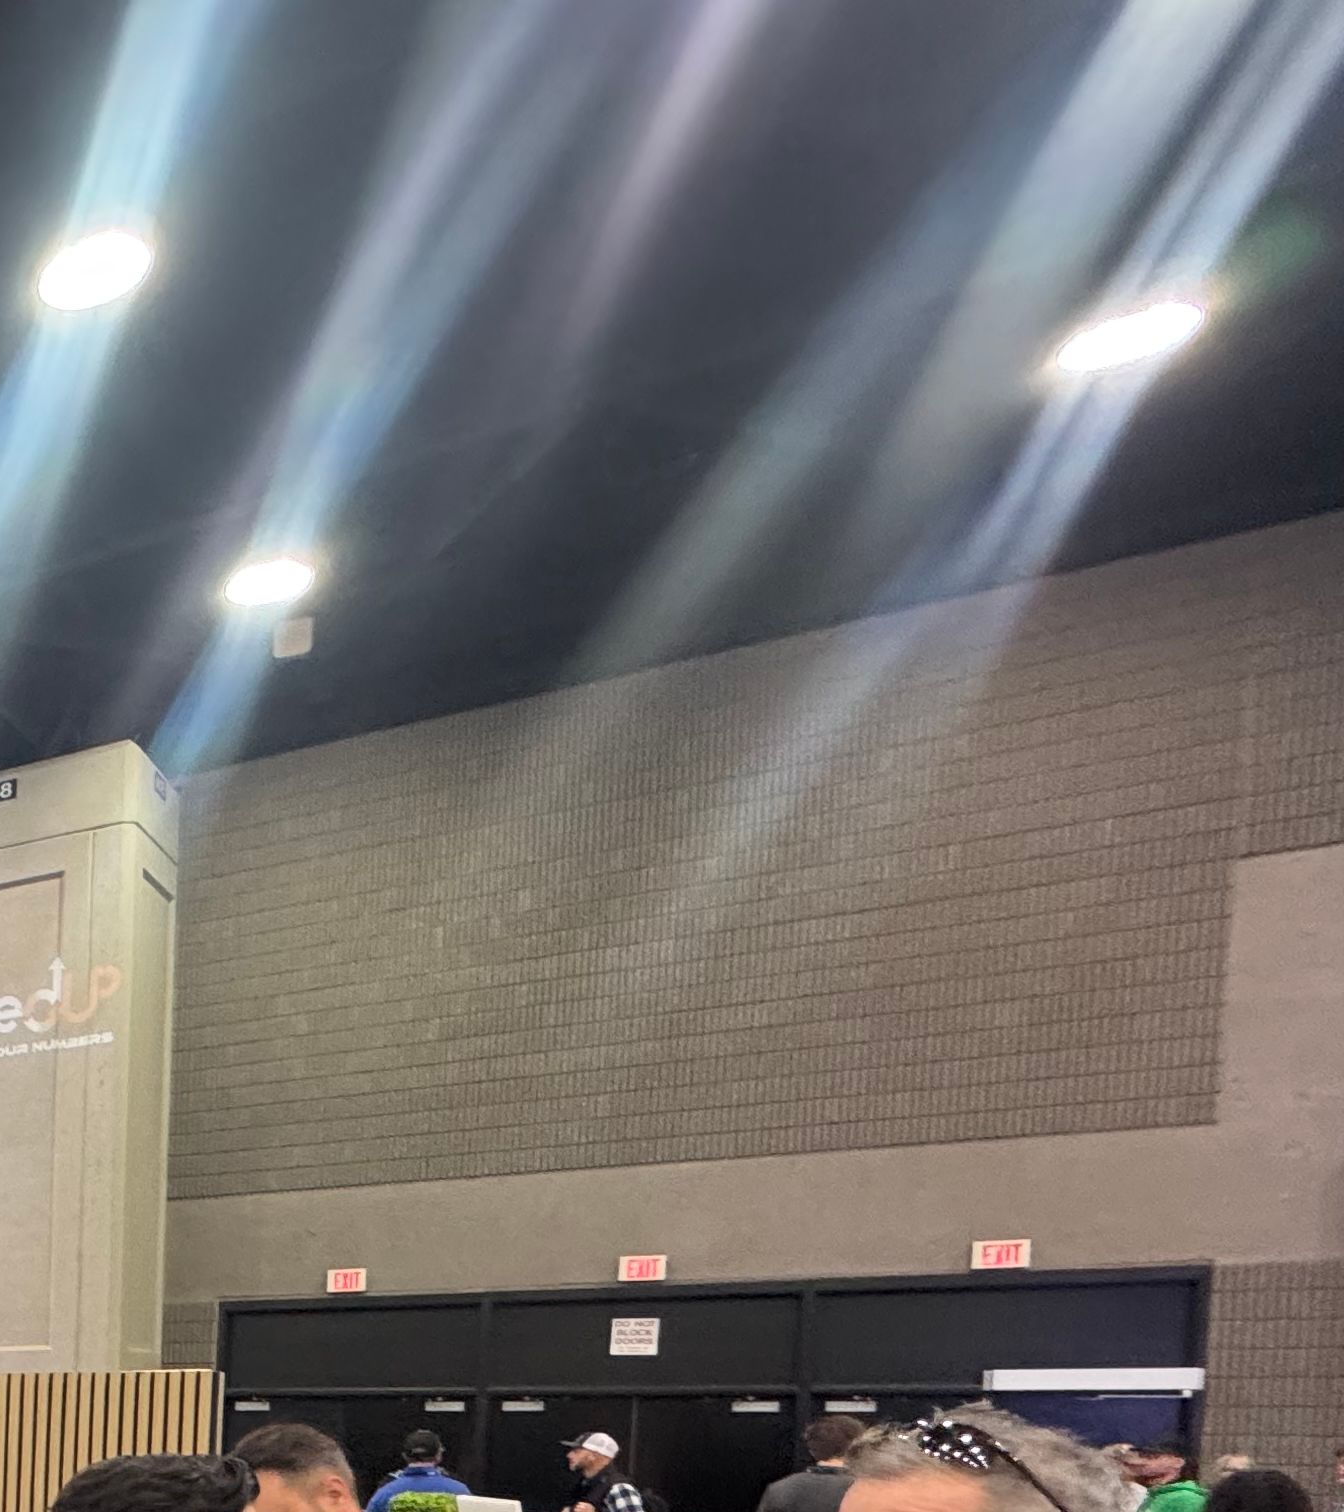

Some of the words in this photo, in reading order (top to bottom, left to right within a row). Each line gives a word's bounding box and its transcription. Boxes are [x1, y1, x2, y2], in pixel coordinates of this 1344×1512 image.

[31, 1031, 115, 1053] NUMBERS
[982, 1244, 1023, 1266] EXIT
[627, 1258, 661, 1279] EXIT
[334, 1272, 361, 1290] EXIT
